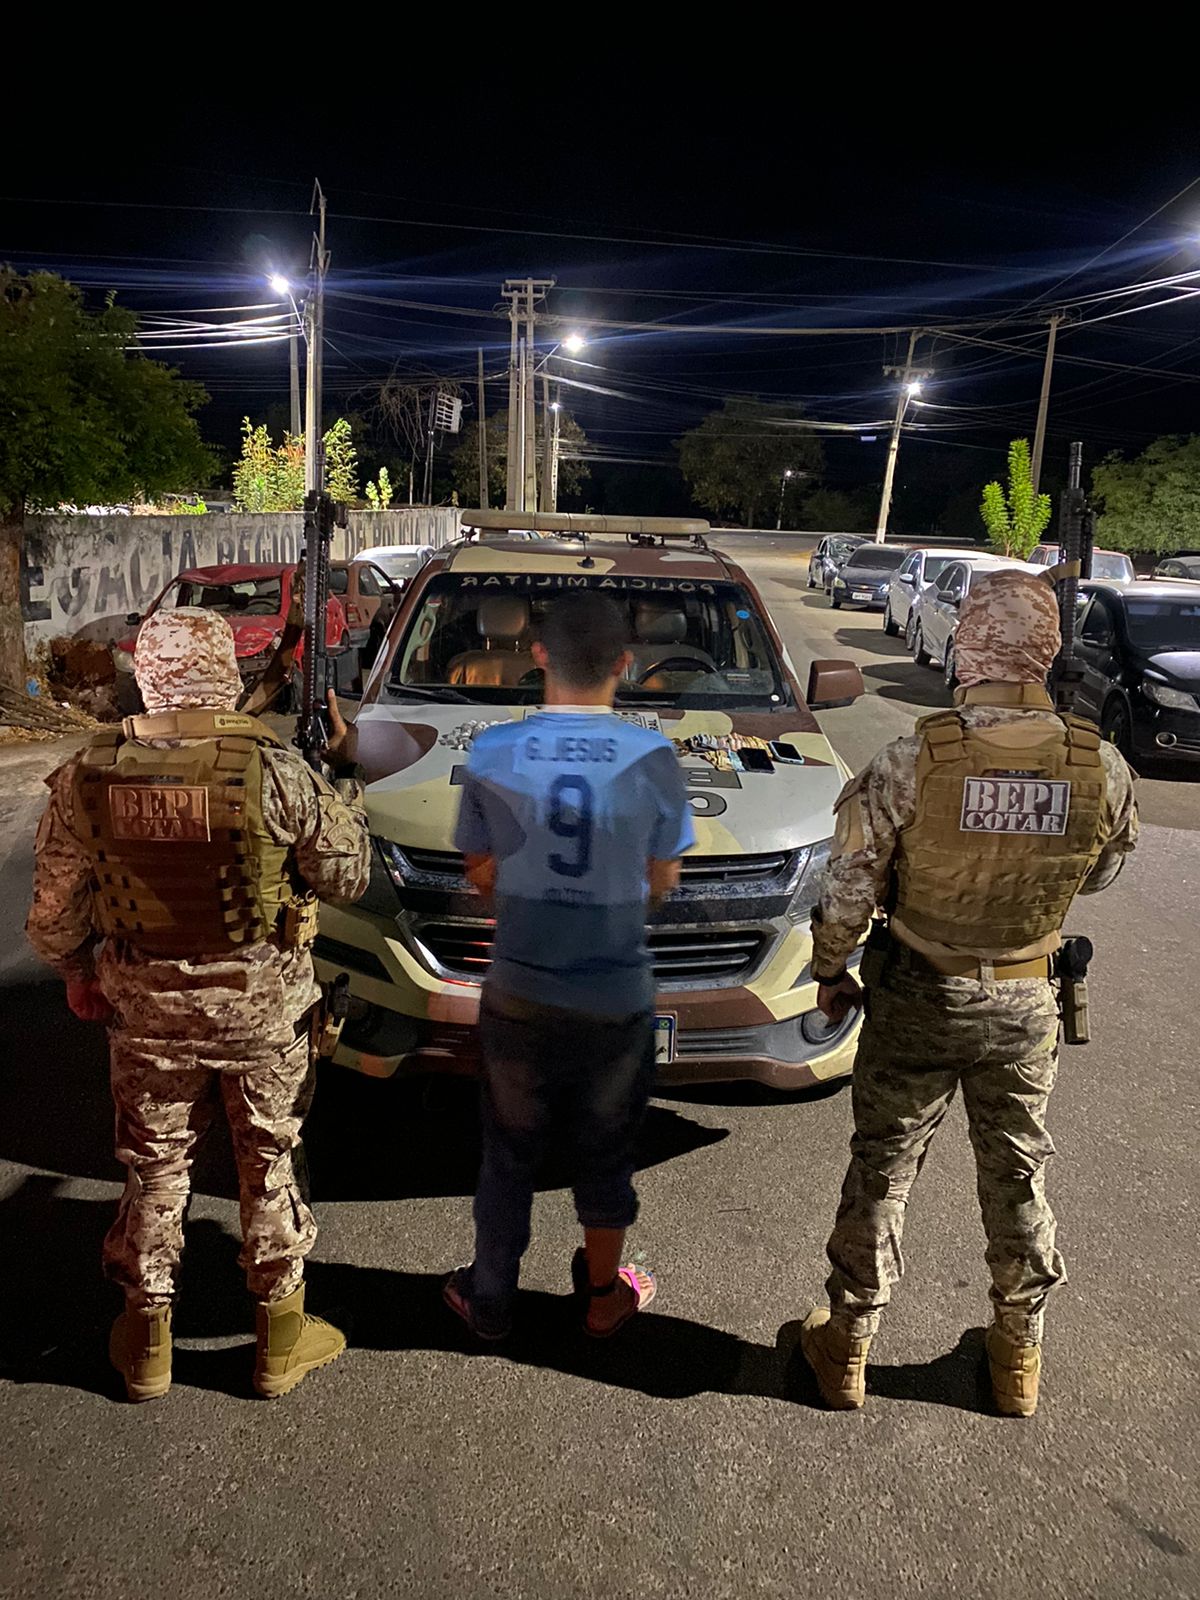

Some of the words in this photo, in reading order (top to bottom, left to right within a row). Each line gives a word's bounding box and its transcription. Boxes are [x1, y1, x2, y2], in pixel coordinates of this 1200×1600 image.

[113, 789, 205, 819] BEPI
[966, 781, 1066, 814] BEPI
[549, 774, 596, 878] 9
[966, 812, 1061, 831] COTAR
